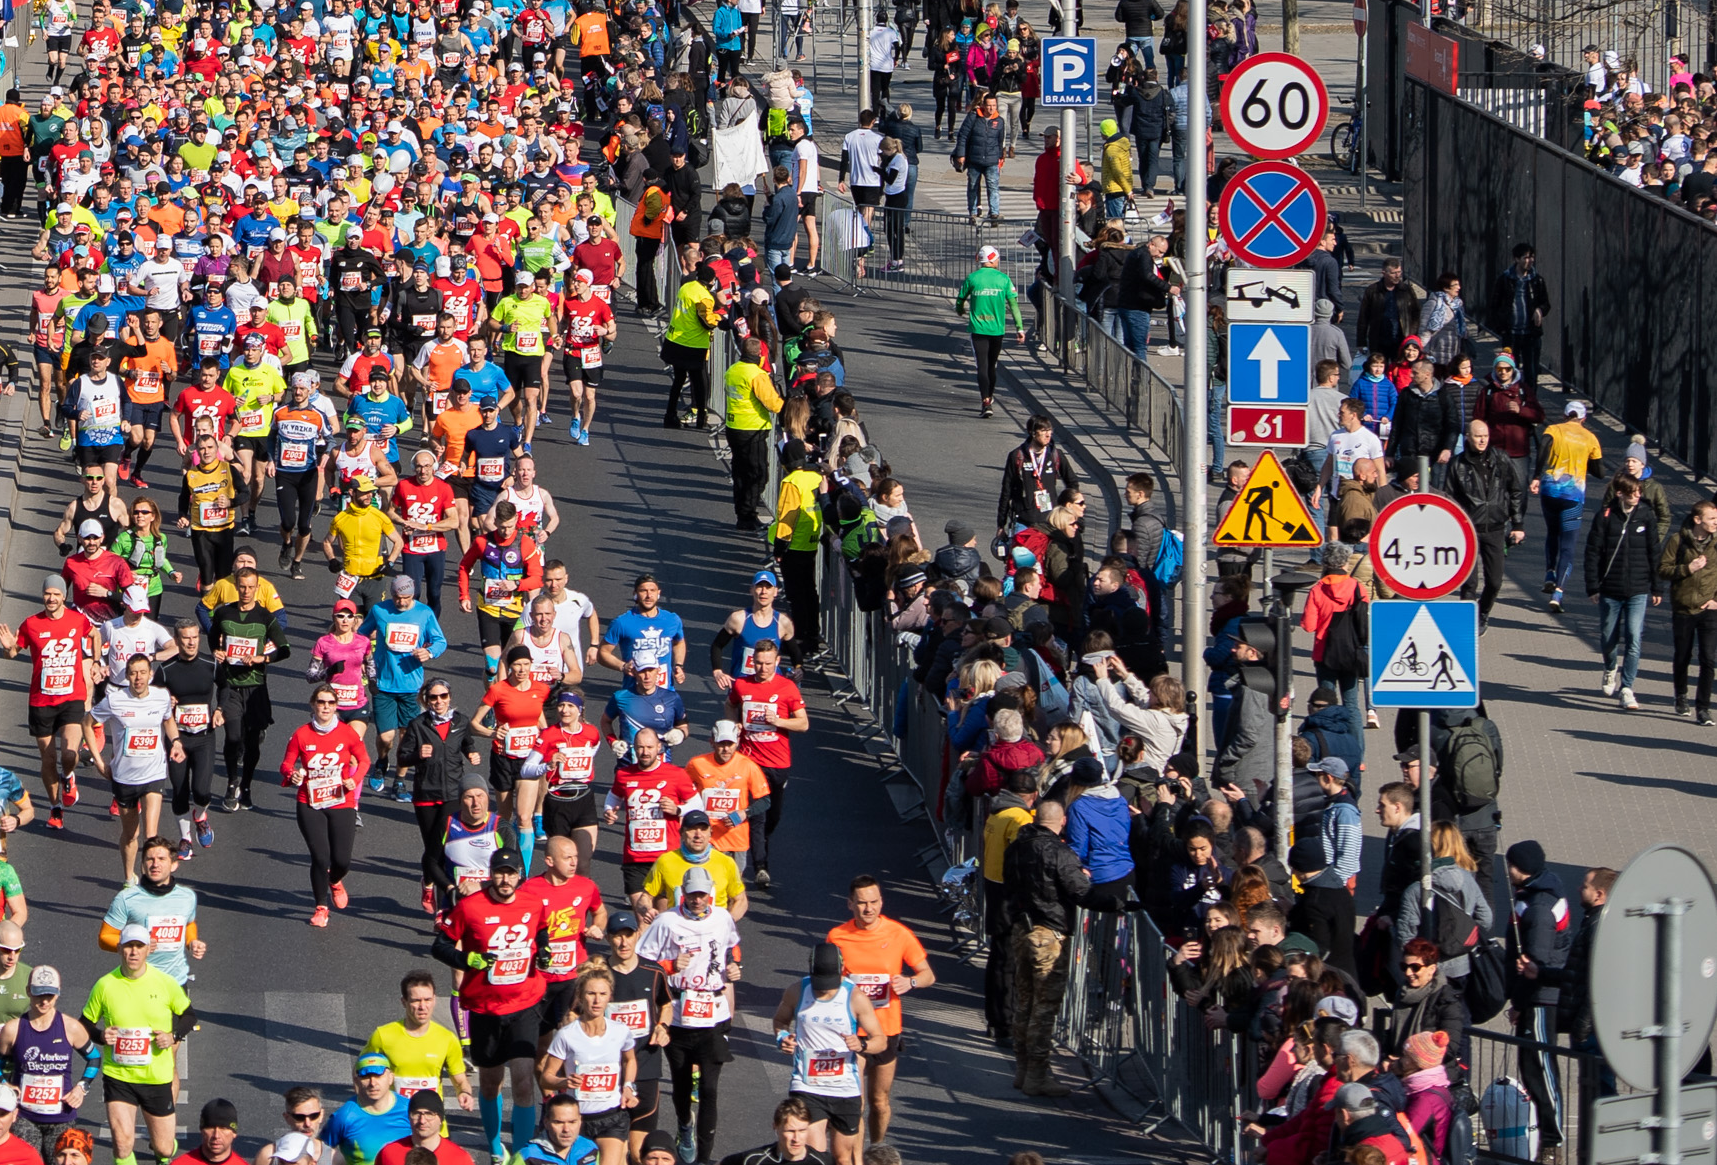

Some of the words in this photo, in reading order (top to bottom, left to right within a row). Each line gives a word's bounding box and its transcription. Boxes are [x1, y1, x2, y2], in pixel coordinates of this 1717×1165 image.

[1052, 55, 1086, 92] P
[1241, 78, 1311, 130] 60
[1253, 413, 1283, 439] 61
[285, 450, 303, 459] 2003
[1383, 538, 1427, 571] 4,5
[1434, 547, 1459, 566] m
[633, 637, 671, 650] JESUS
[182, 714, 204, 724] 6002
[133, 737, 155, 746] 5396
[567, 757, 588, 767] 6214
[711, 798, 734, 809] 1429
[637, 829, 661, 839] 5283
[155, 926, 180, 938] 4080
[499, 959, 524, 972] 4037
[119, 1038, 145, 1051] 5253
[40, 1053, 69, 1061] Markowi
[27, 1061, 68, 1073] Biegacze
[585, 1074, 612, 1087] 5941
[28, 1089, 55, 1101] 3252
